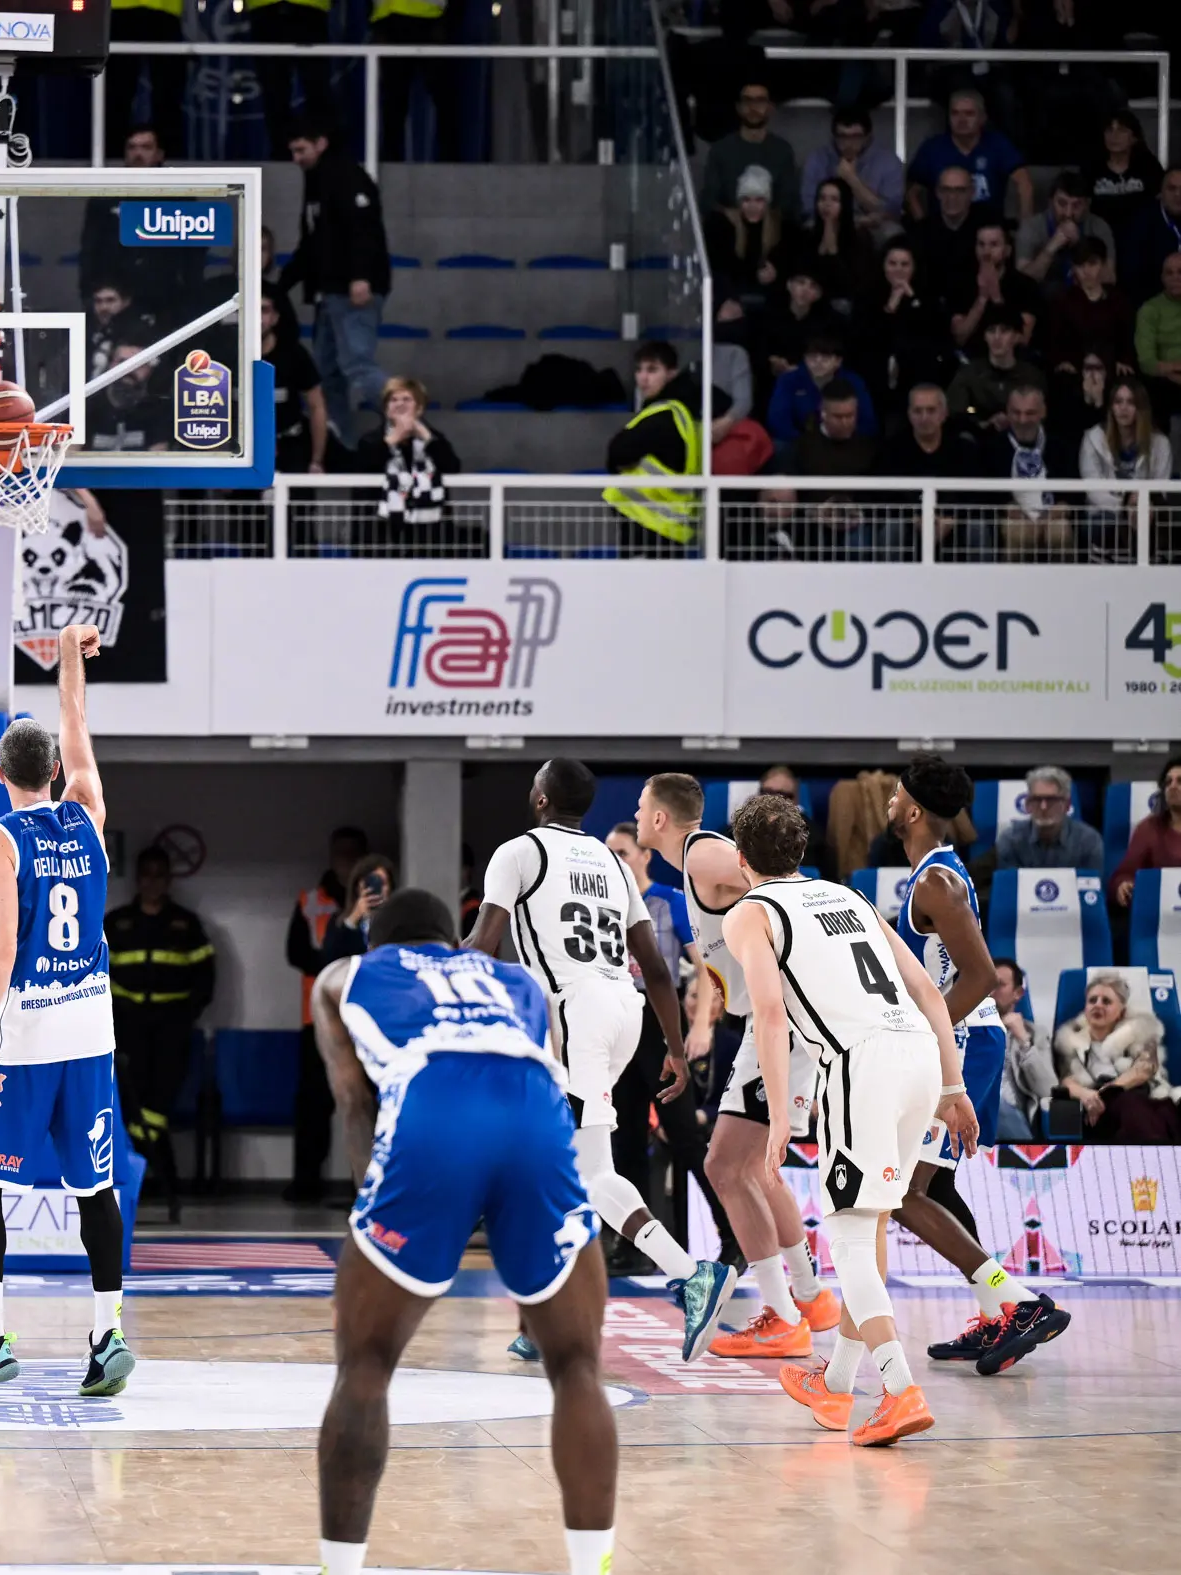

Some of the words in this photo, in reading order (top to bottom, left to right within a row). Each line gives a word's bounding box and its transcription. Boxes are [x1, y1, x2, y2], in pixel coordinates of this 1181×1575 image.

[143, 207, 215, 240] Unipol
[183, 390, 225, 406] LBA
[186, 423, 221, 439] Unipol
[889, 680, 974, 693] SOLUZIONI
[977, 680, 1090, 693] DOCUMENTALI
[1125, 681, 1158, 693] 1980
[385, 695, 535, 717] investments
[569, 870, 610, 900] IKANGI
[48, 882, 80, 952] 8
[813, 908, 867, 937] ZORIKS
[560, 901, 625, 967] 35
[850, 941, 900, 1006] 4
[21, 998, 53, 1010] BRESCIA
[417, 970, 515, 1010] 10
